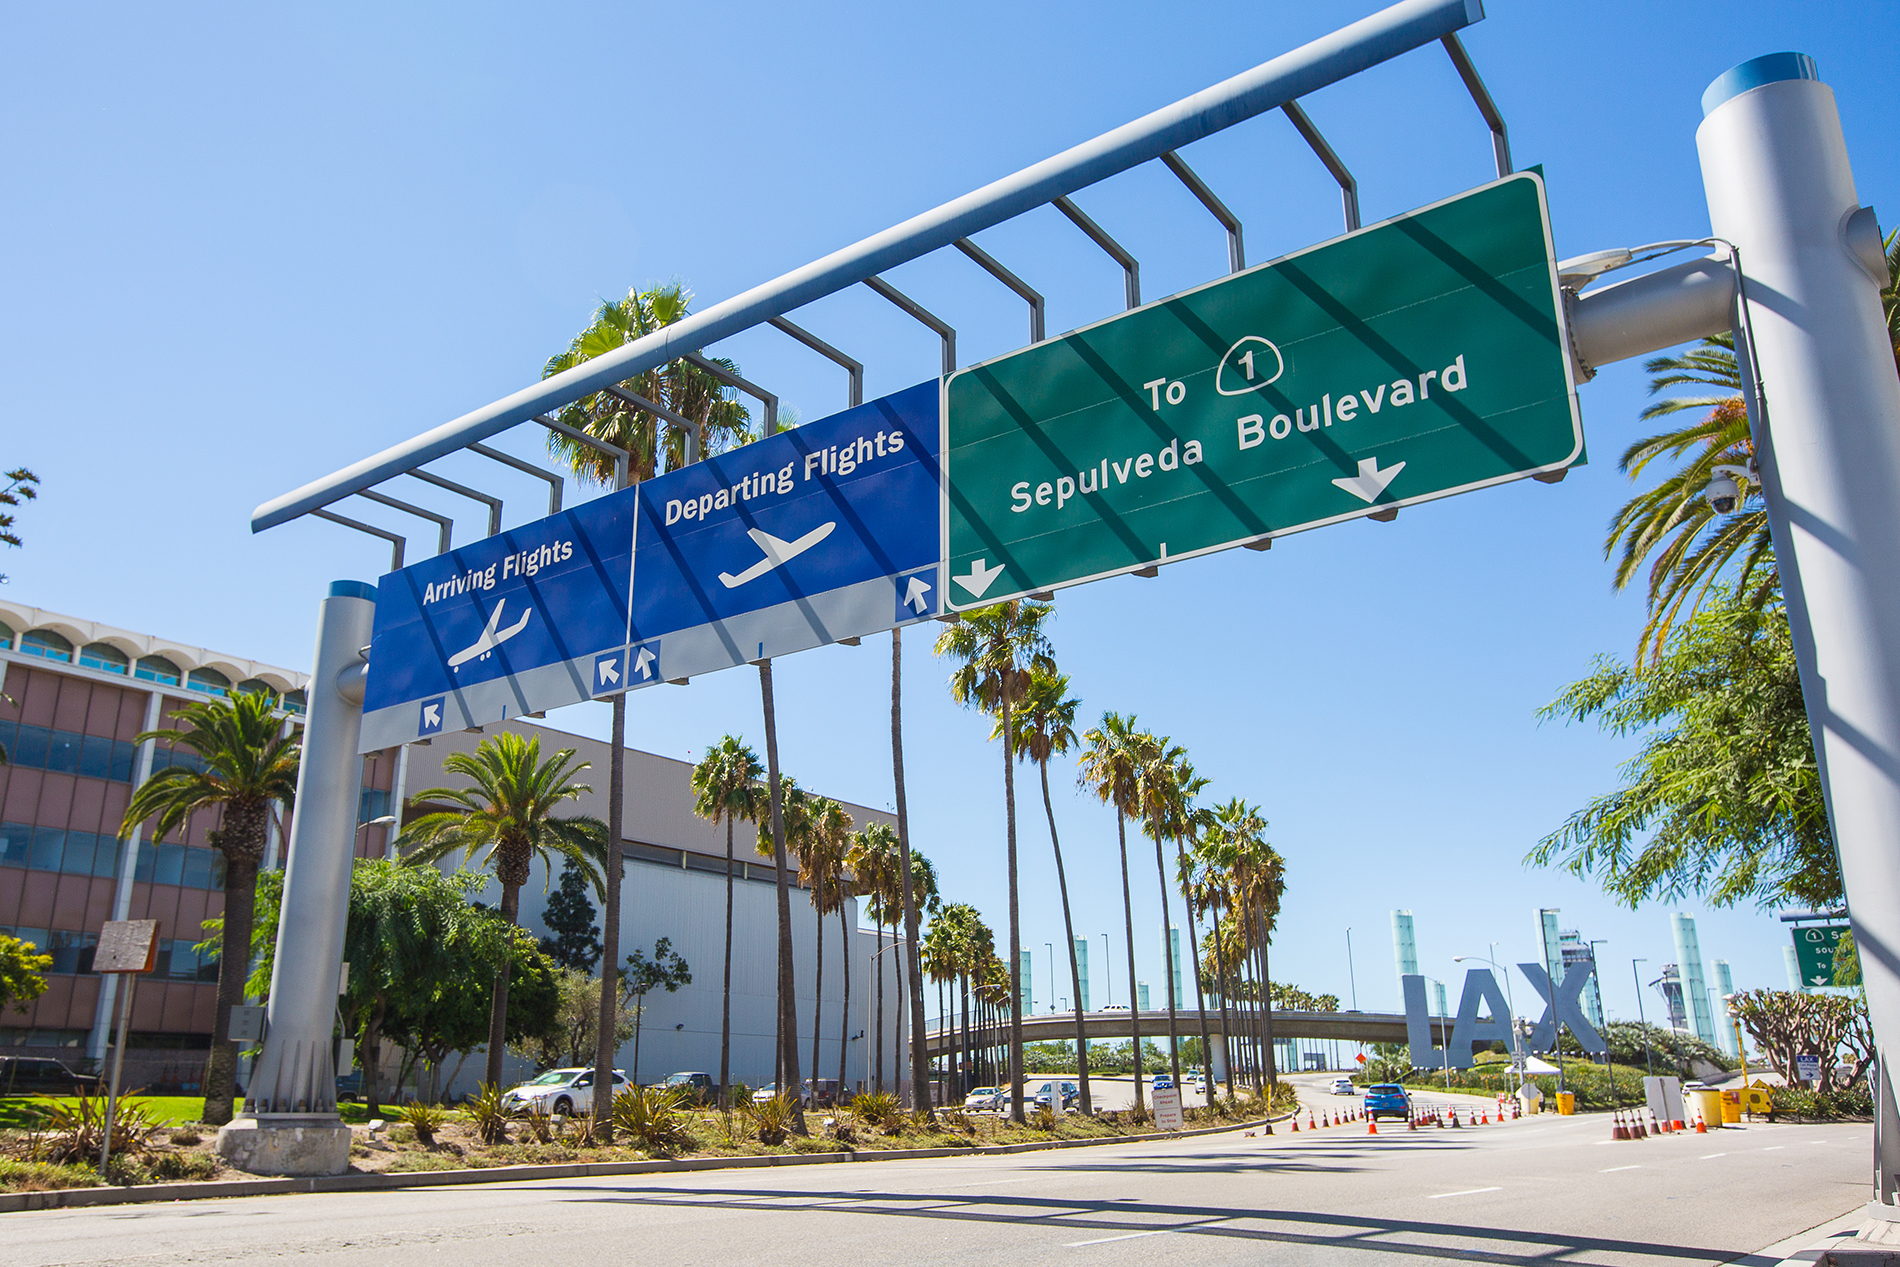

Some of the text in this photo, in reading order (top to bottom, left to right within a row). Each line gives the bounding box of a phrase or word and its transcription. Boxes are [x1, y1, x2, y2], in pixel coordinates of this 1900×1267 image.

[1143, 350, 1255, 412] To 1
[665, 430, 905, 527] Departing Flights
[1010, 353, 1468, 513] Sepulveda Boulevard
[422, 540, 573, 606] Arriving Flights
[1401, 961, 1607, 1069] LAX
